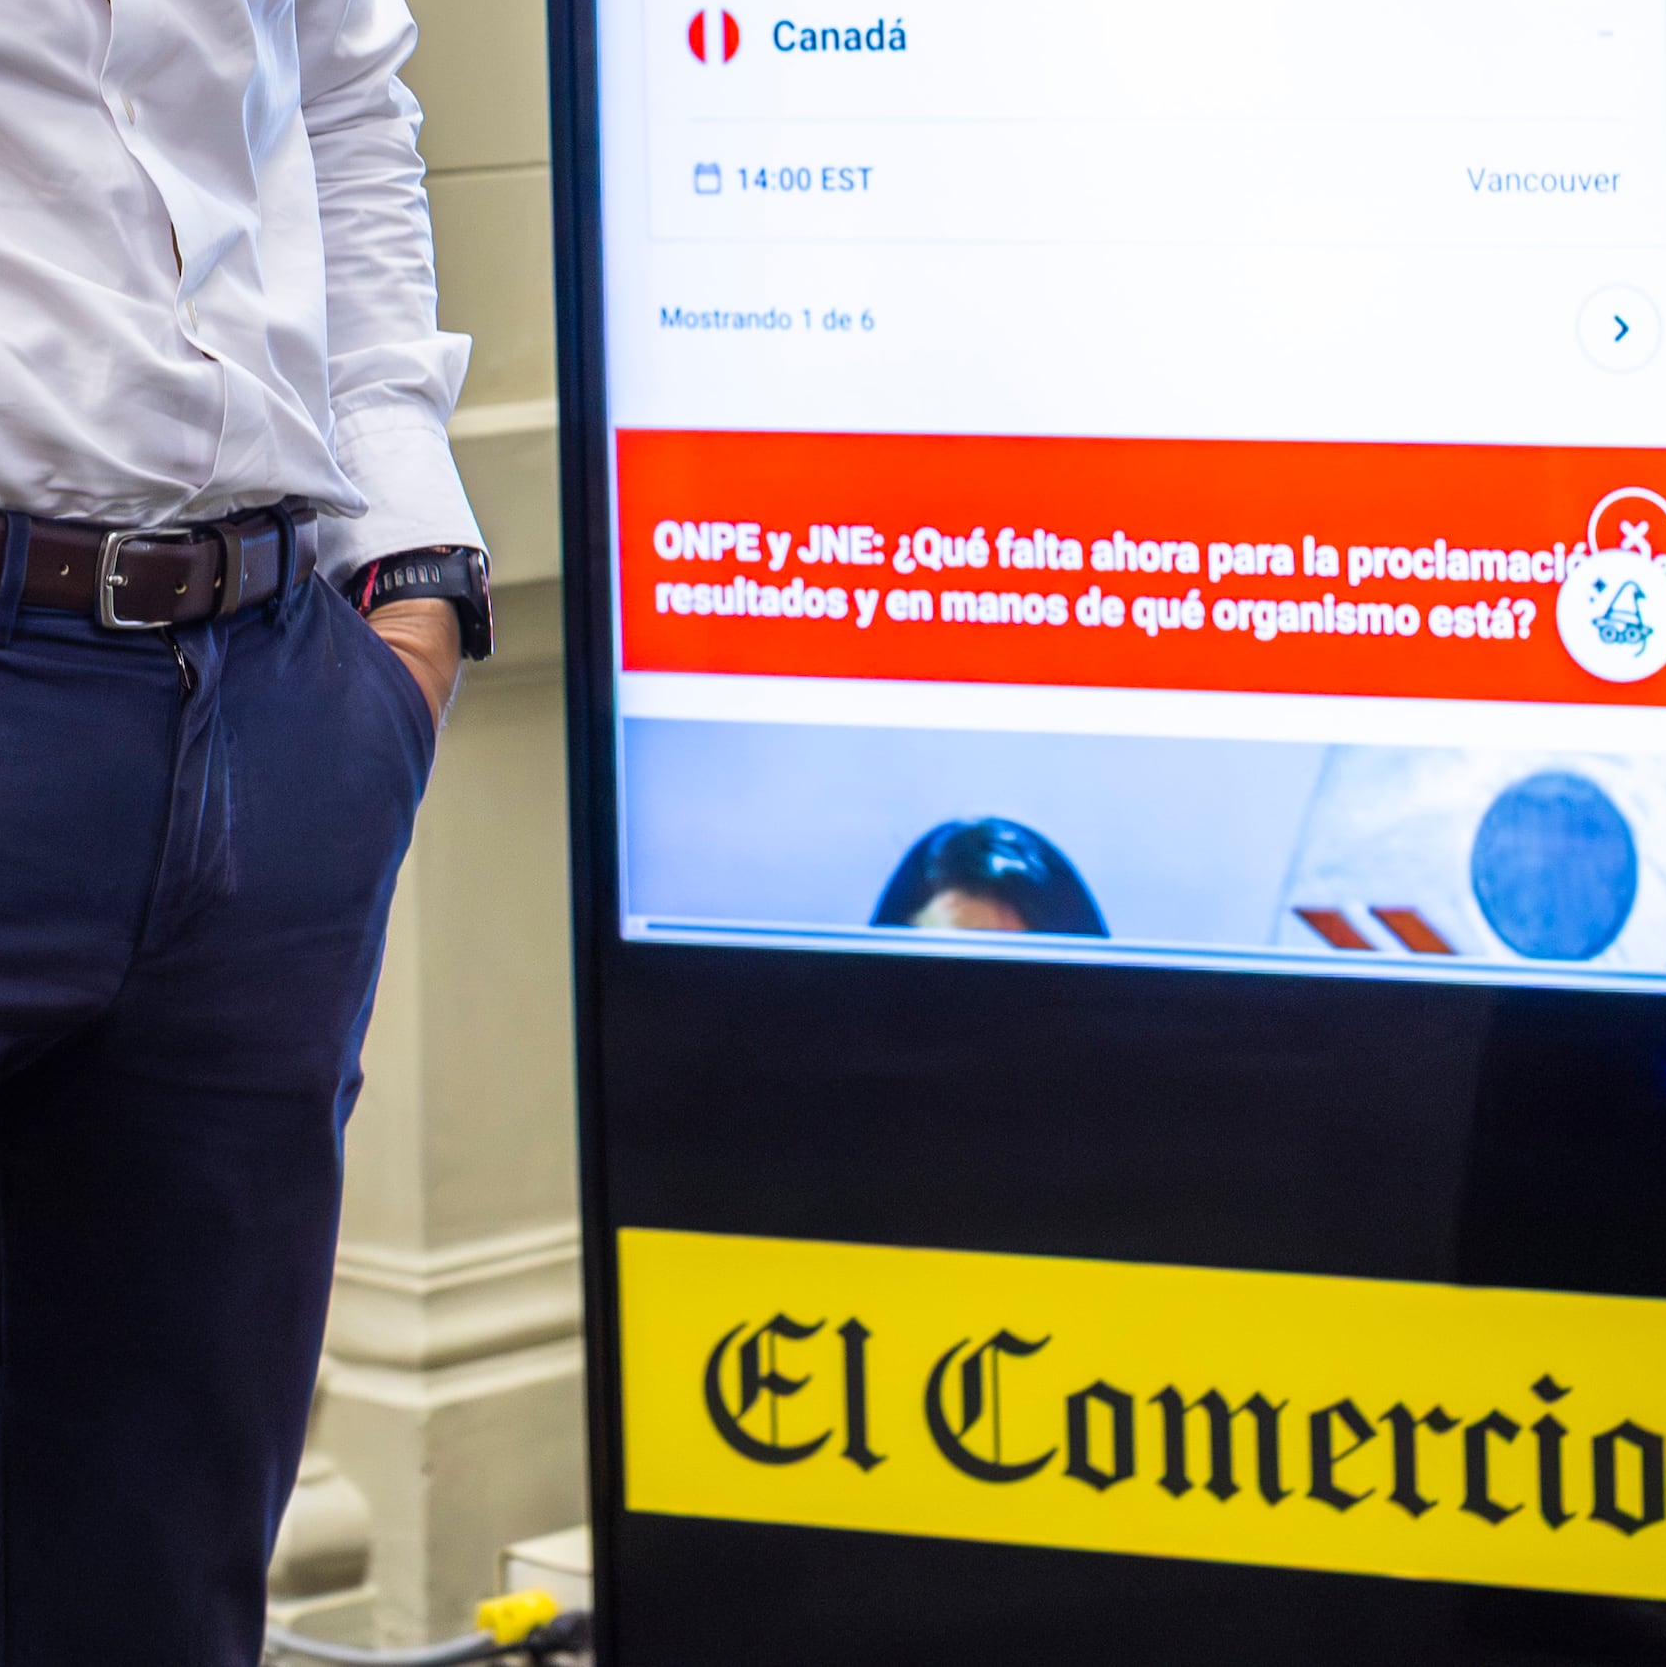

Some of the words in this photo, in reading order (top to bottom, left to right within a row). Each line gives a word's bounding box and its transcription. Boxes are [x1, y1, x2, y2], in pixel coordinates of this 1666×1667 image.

[772, 17, 908, 53] Canadá
[736, 167, 813, 193] 14:00
[820, 167, 874, 193] EST
[1465, 167, 1622, 194] Vancouver
[661, 306, 792, 332] Mostrando
[801, 308, 813, 331] 1
[822, 308, 853, 332] de
[861, 308, 876, 332] 6
[653, 519, 762, 563] ONPE
[767, 529, 792, 572] y
[796, 524, 885, 566] JNE:
[892, 526, 990, 575] ¿Qué
[995, 527, 1083, 572] falta
[1090, 529, 1200, 574] ahora
[1207, 538, 1295, 584] para
[1302, 534, 1340, 578] la
[654, 574, 849, 621] resultados
[852, 587, 880, 631] y
[884, 588, 935, 622] en
[940, 590, 1069, 627] manos
[1075, 585, 1126, 629] de
[1131, 587, 1205, 638] qué
[1211, 592, 1421, 642] organismo
[1427, 597, 1537, 641] está?
[701, 1310, 891, 1475] El
